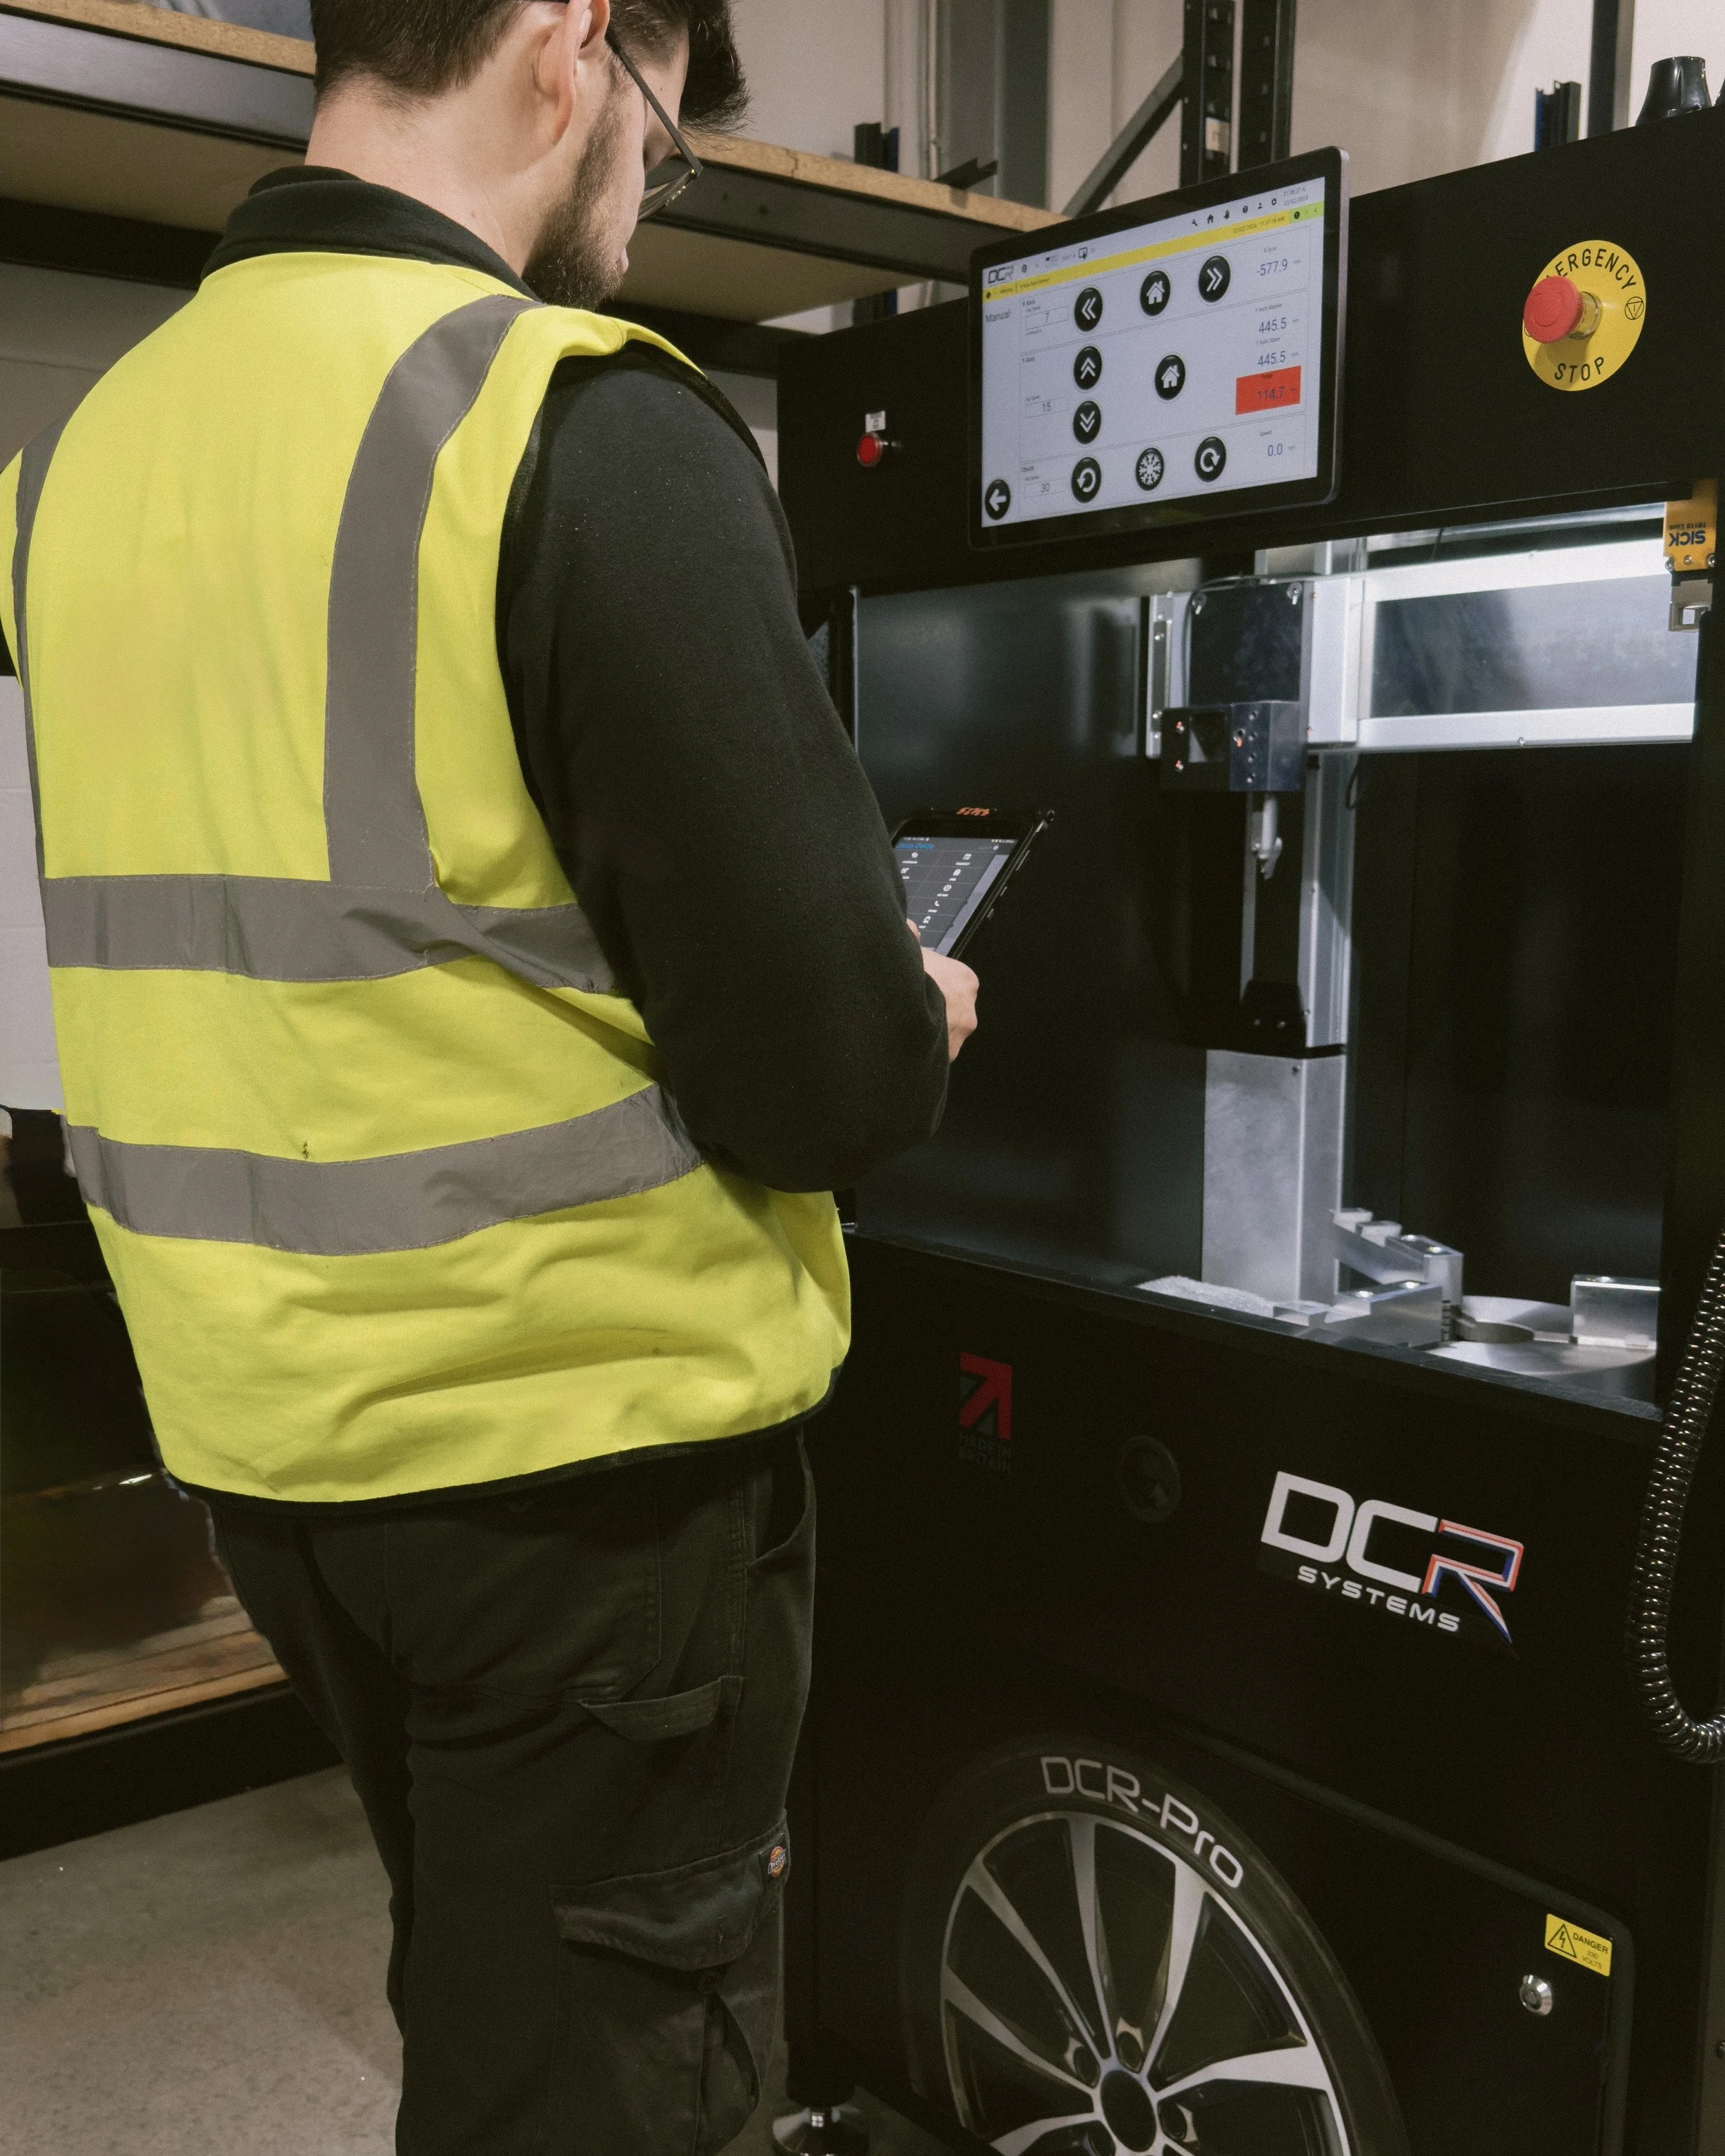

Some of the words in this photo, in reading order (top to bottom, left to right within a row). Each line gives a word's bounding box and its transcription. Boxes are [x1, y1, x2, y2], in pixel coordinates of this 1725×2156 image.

[987, 265, 1014, 284] DCR
[1256, 259, 1288, 276] -577.9
[1546, 248, 1637, 290] ERGENCY
[985, 309, 1011, 323] Manual
[1259, 317, 1287, 333] 445.5
[1258, 350, 1286, 367] 445.5
[1554, 356, 1604, 383] STOP
[1043, 402, 1052, 413] 15
[1267, 443, 1283, 457] 0.0
[1041, 482, 1050, 493] 30
[1668, 530, 1706, 547] SICK
[1261, 1471, 1524, 1645] DCR
[1297, 1565, 1461, 1633] SYSTEMS
[1041, 1757, 1243, 1888] DCR-Pro
[1573, 1932, 1608, 1955] DANGER
[1582, 1955, 1603, 1970] VOLTS
